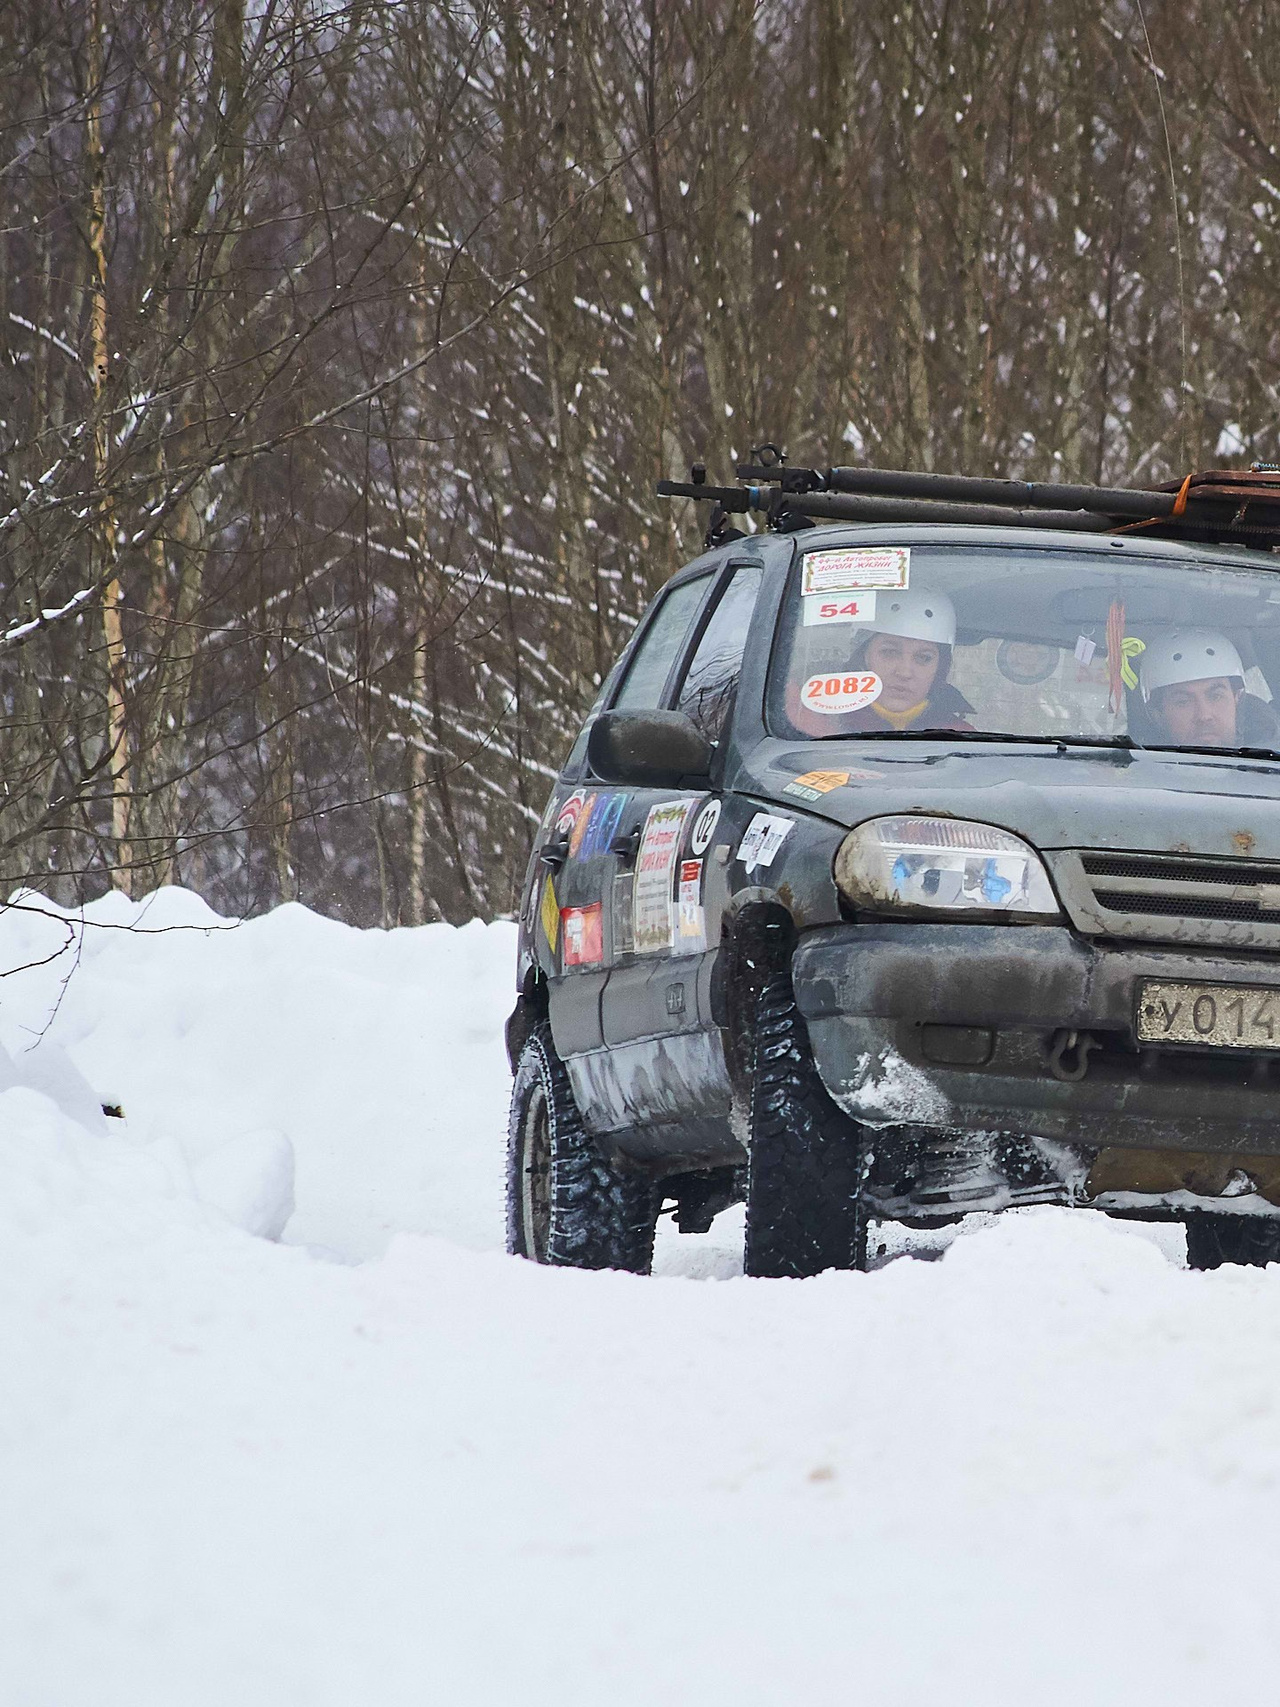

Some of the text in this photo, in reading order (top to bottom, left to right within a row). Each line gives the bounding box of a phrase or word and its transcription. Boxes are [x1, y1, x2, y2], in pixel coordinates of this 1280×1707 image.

[820, 602, 859, 618] 54
[807, 676, 877, 698] 2082
[696, 809, 717, 844] 02
